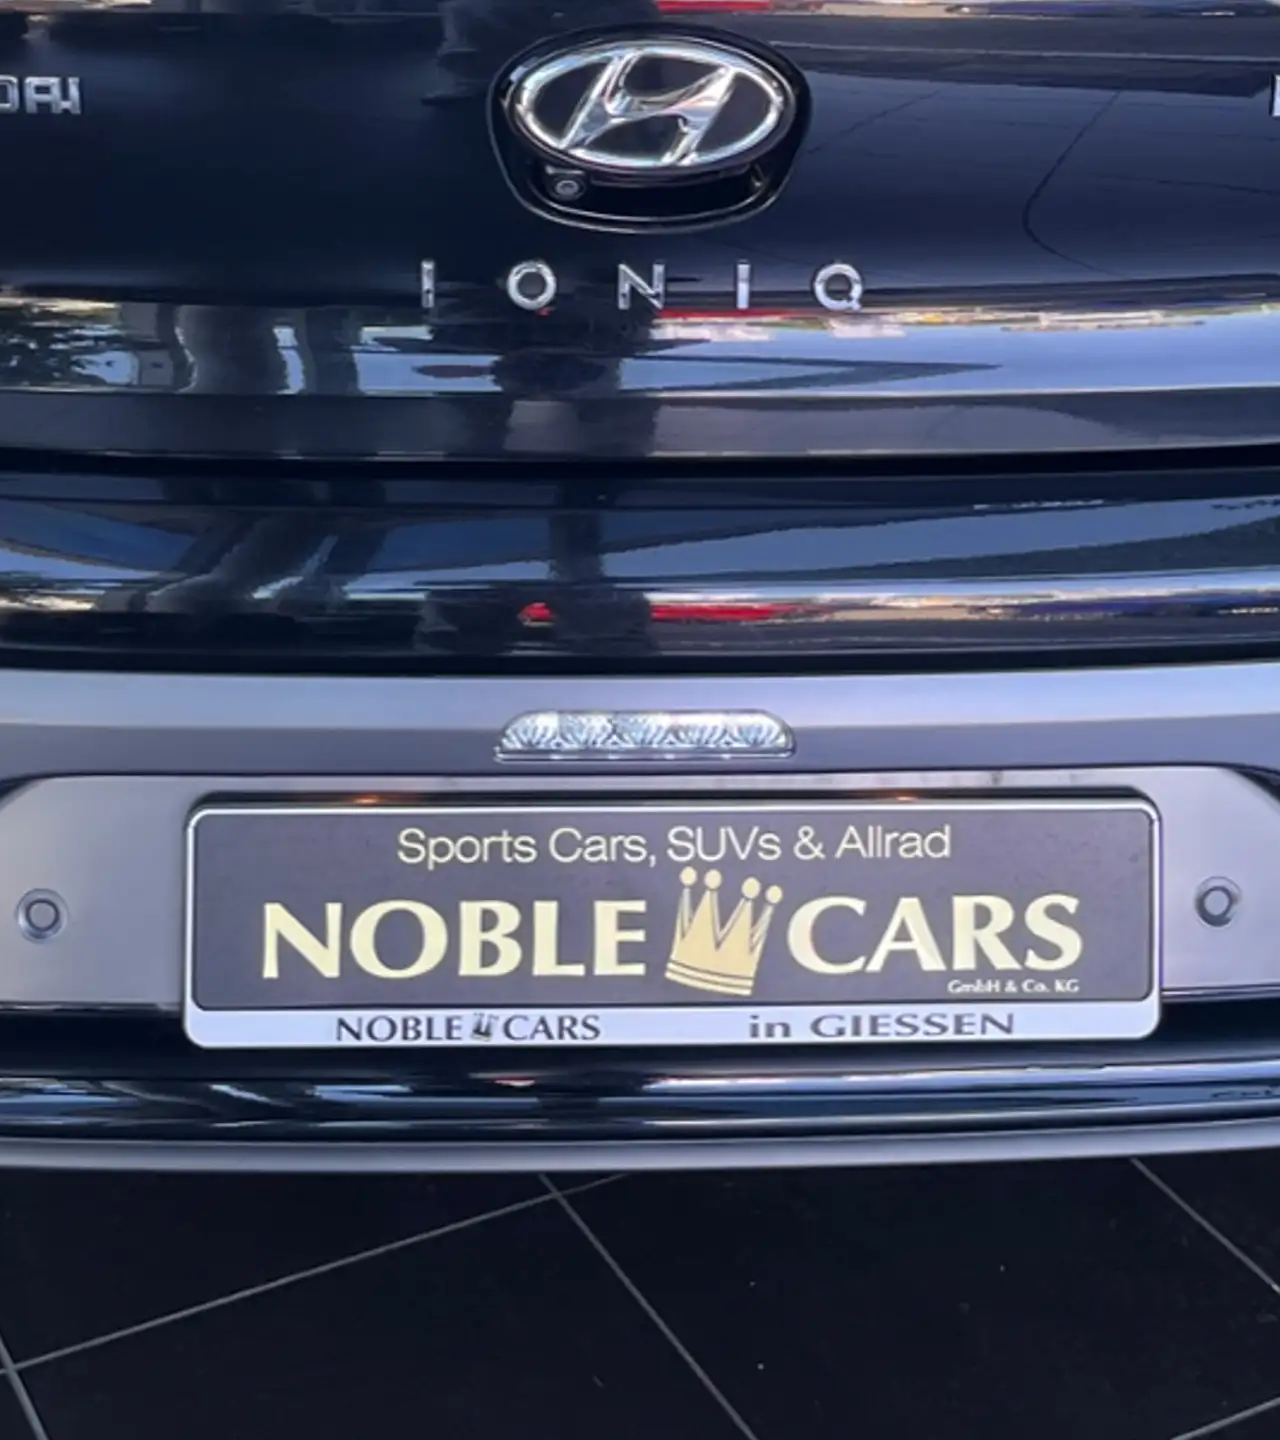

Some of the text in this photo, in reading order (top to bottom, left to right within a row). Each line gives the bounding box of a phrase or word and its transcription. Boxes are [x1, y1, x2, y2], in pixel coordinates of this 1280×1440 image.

[420, 260, 864, 311] IONIQ
[397, 824, 951, 870] Sports Cars, SUVs & Allrad
[262, 893, 1083, 979] NOBLE CARS
[947, 979, 1080, 994] GmbH & Co. KG
[336, 1013, 1014, 1042] NOBLE CARS in GIESSEN
